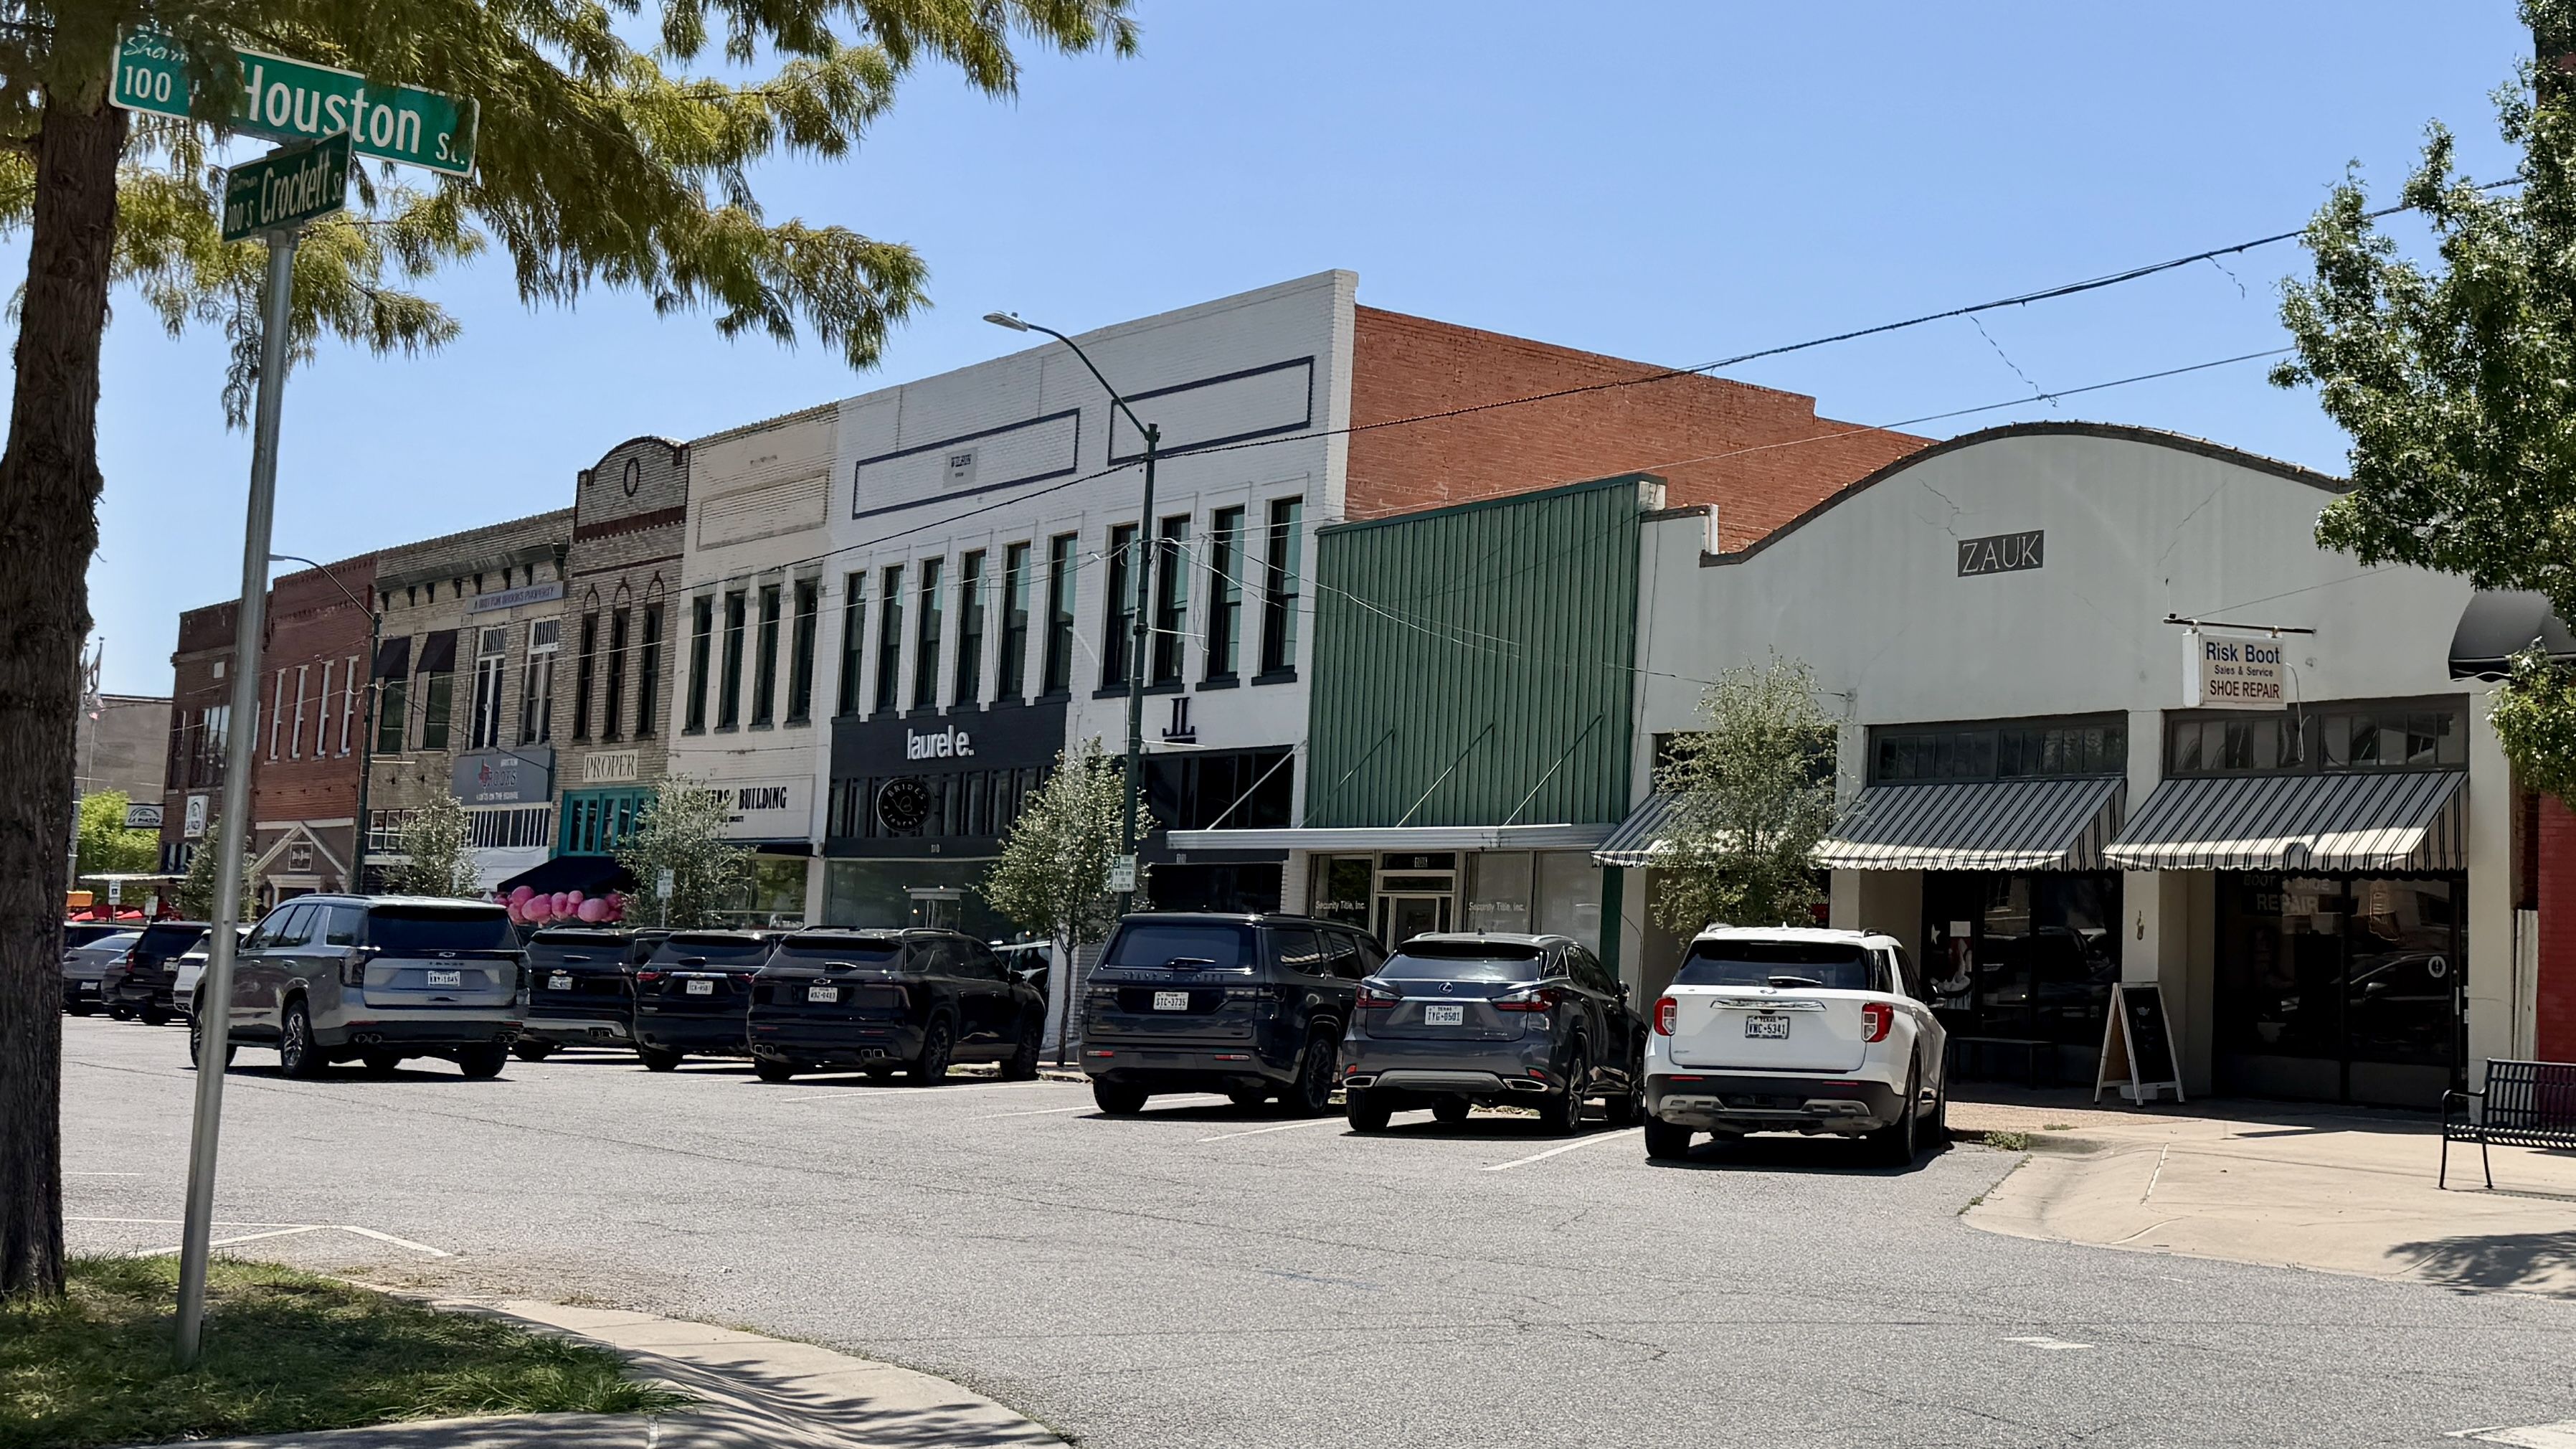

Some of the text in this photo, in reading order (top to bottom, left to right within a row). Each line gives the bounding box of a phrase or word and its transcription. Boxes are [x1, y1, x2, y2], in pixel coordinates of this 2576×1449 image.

[125, 66, 171, 103] 100
[231, 60, 422, 154] Houston
[246, 199, 254, 228] S
[260, 148, 331, 225] Crockett
[1962, 534, 2040, 573] ZAUK
[2206, 641, 2281, 664] Risk Boot
[2215, 664, 2273, 677] Sales & Service
[2210, 679, 2281, 699] SHOE REPAIR
[907, 724, 954, 760] laurel
[584, 754, 635, 778] PROPER
[738, 786, 787, 811] BUILDING
[886, 783, 926, 801] BRIDES
[2256, 893, 2319, 913] REPAIR
